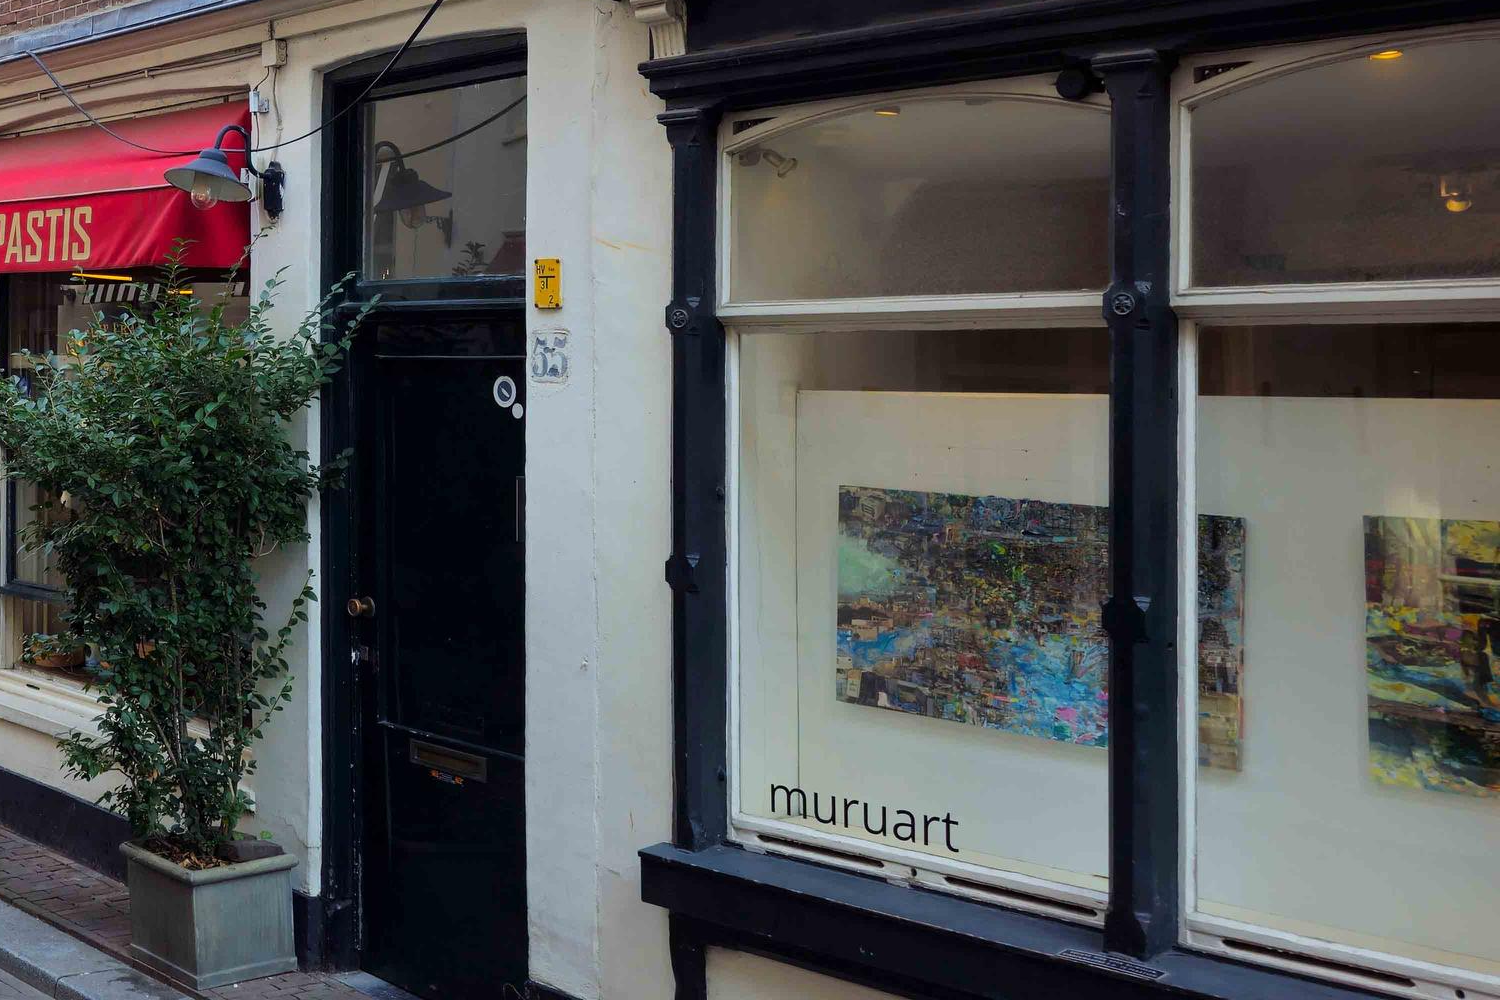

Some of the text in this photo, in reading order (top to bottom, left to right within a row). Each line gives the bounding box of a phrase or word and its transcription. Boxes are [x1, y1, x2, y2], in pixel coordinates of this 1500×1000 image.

[548, 294, 554, 304] 2
[531, 337, 568, 378] 55
[770, 783, 960, 853] muruart
